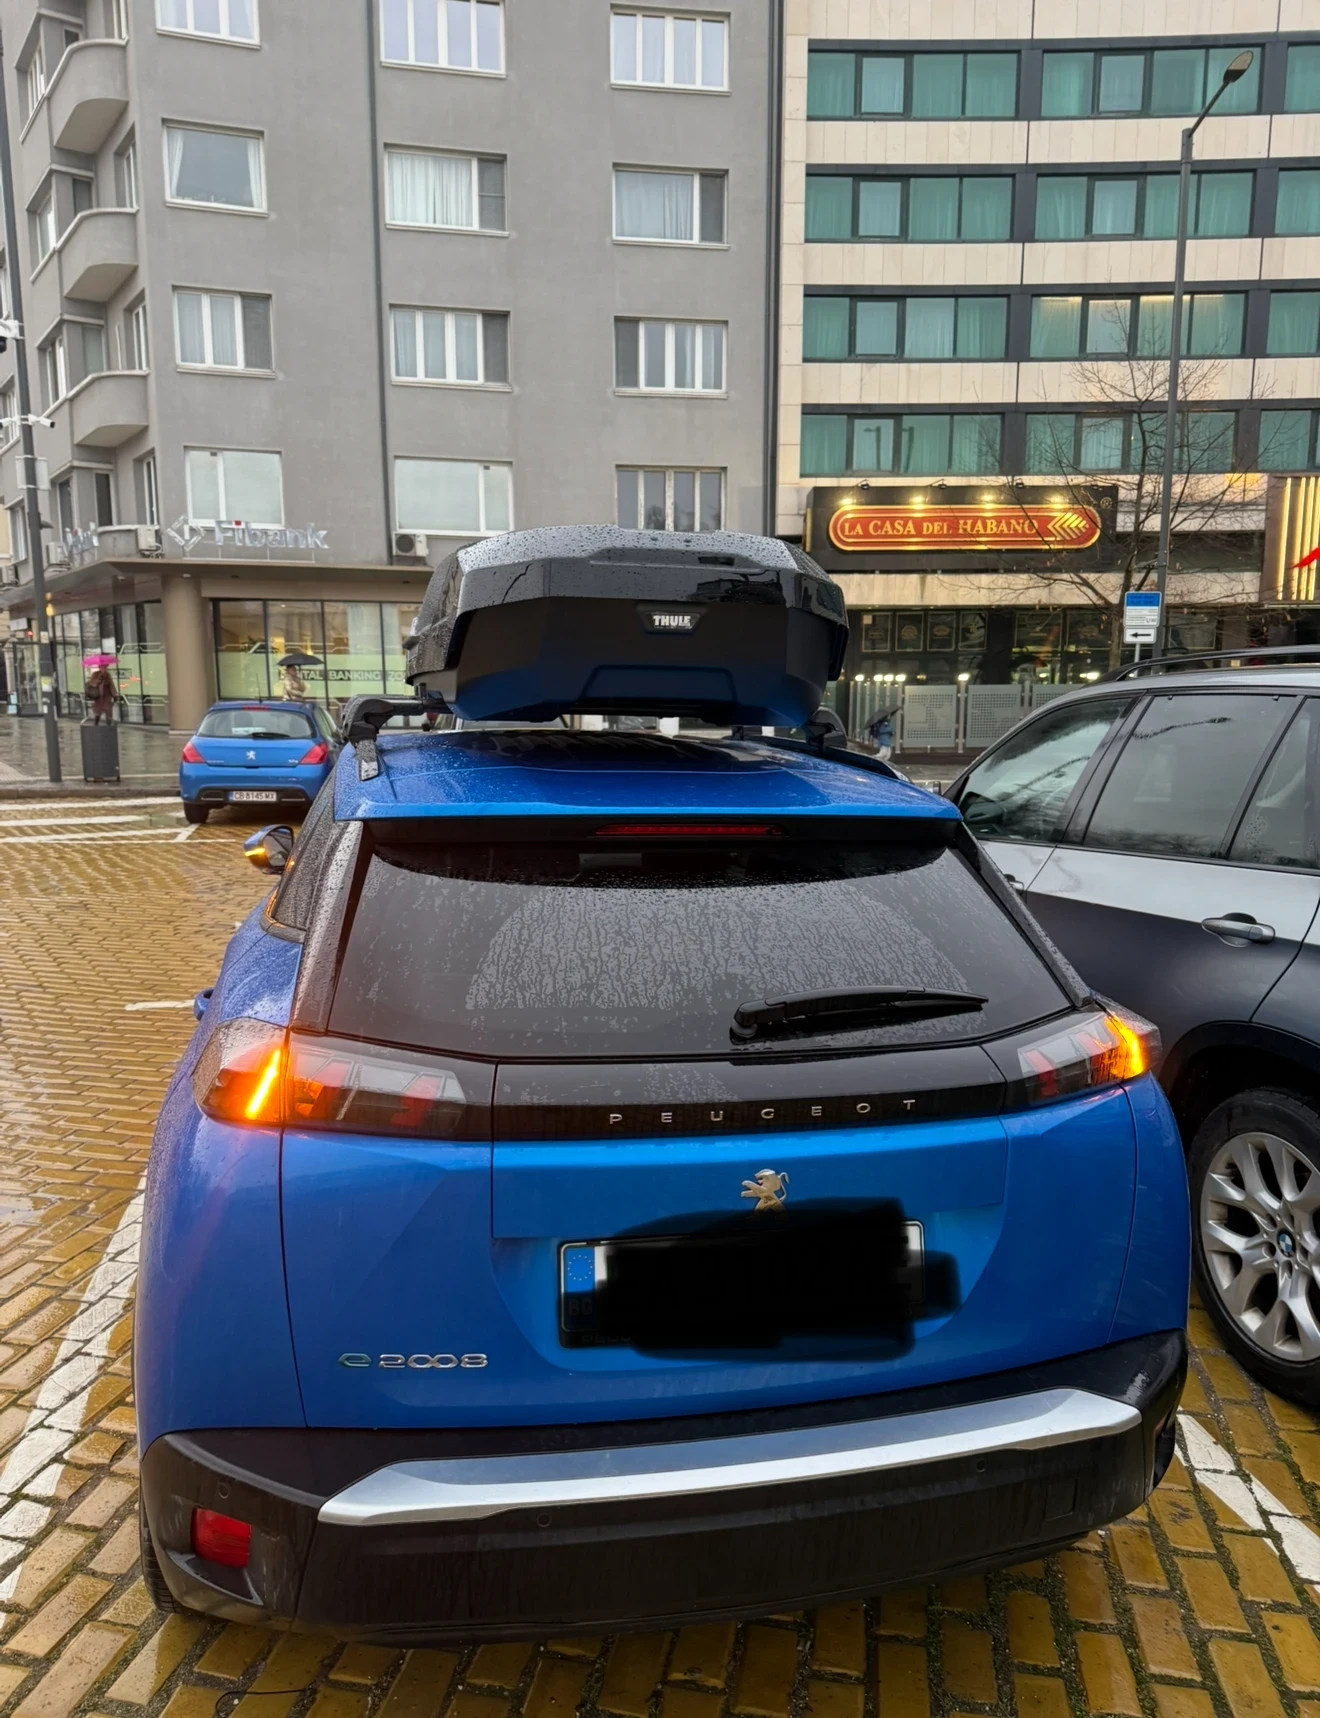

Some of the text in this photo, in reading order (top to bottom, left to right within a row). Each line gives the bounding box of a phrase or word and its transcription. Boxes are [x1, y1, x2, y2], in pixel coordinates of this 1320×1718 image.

[214, 519, 330, 549] Fibank
[843, 519, 1039, 535] LA CASA DEL HABANO
[652, 615, 692, 627] THULE
[329, 671, 381, 681] BANKING
[387, 671, 404, 681] ZO
[608, 1099, 916, 1125] PEUGEOT
